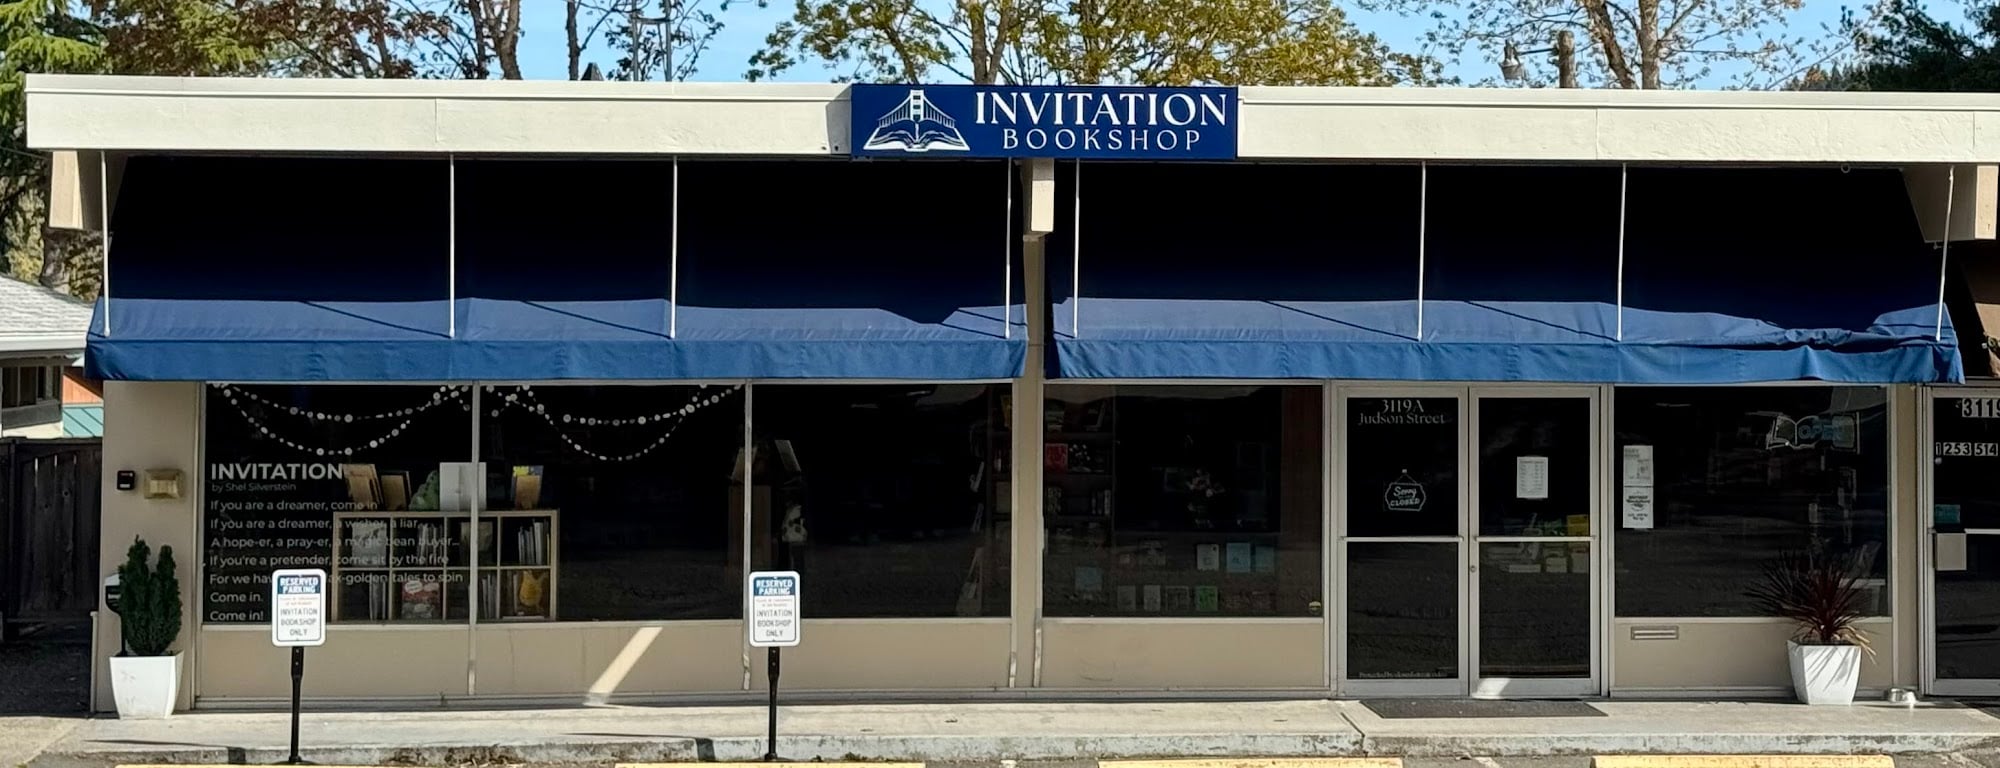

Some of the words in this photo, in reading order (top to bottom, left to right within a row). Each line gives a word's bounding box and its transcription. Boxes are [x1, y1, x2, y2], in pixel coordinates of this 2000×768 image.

[975, 91, 1227, 126] INVITATION
[1003, 128, 1200, 151] BOOKSHOP
[1381, 399, 1424, 414] 3119A
[1357, 411, 1403, 426] Judson
[1406, 412, 1446, 424] Street
[1944, 443, 1971, 455] 253
[1975, 443, 1997, 455] 514
[211, 463, 343, 480] INVITATION
[211, 484, 224, 494] by
[225, 482, 246, 492] Shel
[248, 482, 297, 492] Silverstein
[210, 500, 219, 510] If
[220, 501, 242, 513] you
[244, 501, 264, 510] are
[266, 502, 274, 510] a
[276, 500, 328, 512] dreamer,
[330, 502, 365, 510] come
[1390, 498, 1420, 506] CLOSED
[210, 518, 219, 528] If
[220, 519, 243, 531] you
[246, 519, 266, 528] are
[268, 520, 276, 528] a
[278, 518, 332, 529] dreamer,
[210, 538, 220, 548] A
[222, 537, 274, 549] hope-er,
[276, 538, 284, 547] a
[286, 538, 332, 549] pray-er,
[210, 555, 219, 565] If
[220, 555, 256, 568] you're
[259, 556, 267, 566] a
[270, 554, 332, 567] pretender,
[406, 554, 426, 566] the
[210, 574, 230, 584] For
[231, 575, 250, 584] we
[253, 574, 272, 584] hav
[392, 573, 420, 582] tales
[422, 573, 436, 582] to
[280, 577, 318, 586] RESERVED
[756, 580, 793, 588] RESERVED
[210, 592, 247, 602] Come
[210, 610, 247, 622] Come
[249, 610, 264, 621] in!
[280, 608, 318, 616] INVITATION
[280, 618, 317, 626] BOOKSHOP
[757, 619, 792, 627] BOOKSHOP
